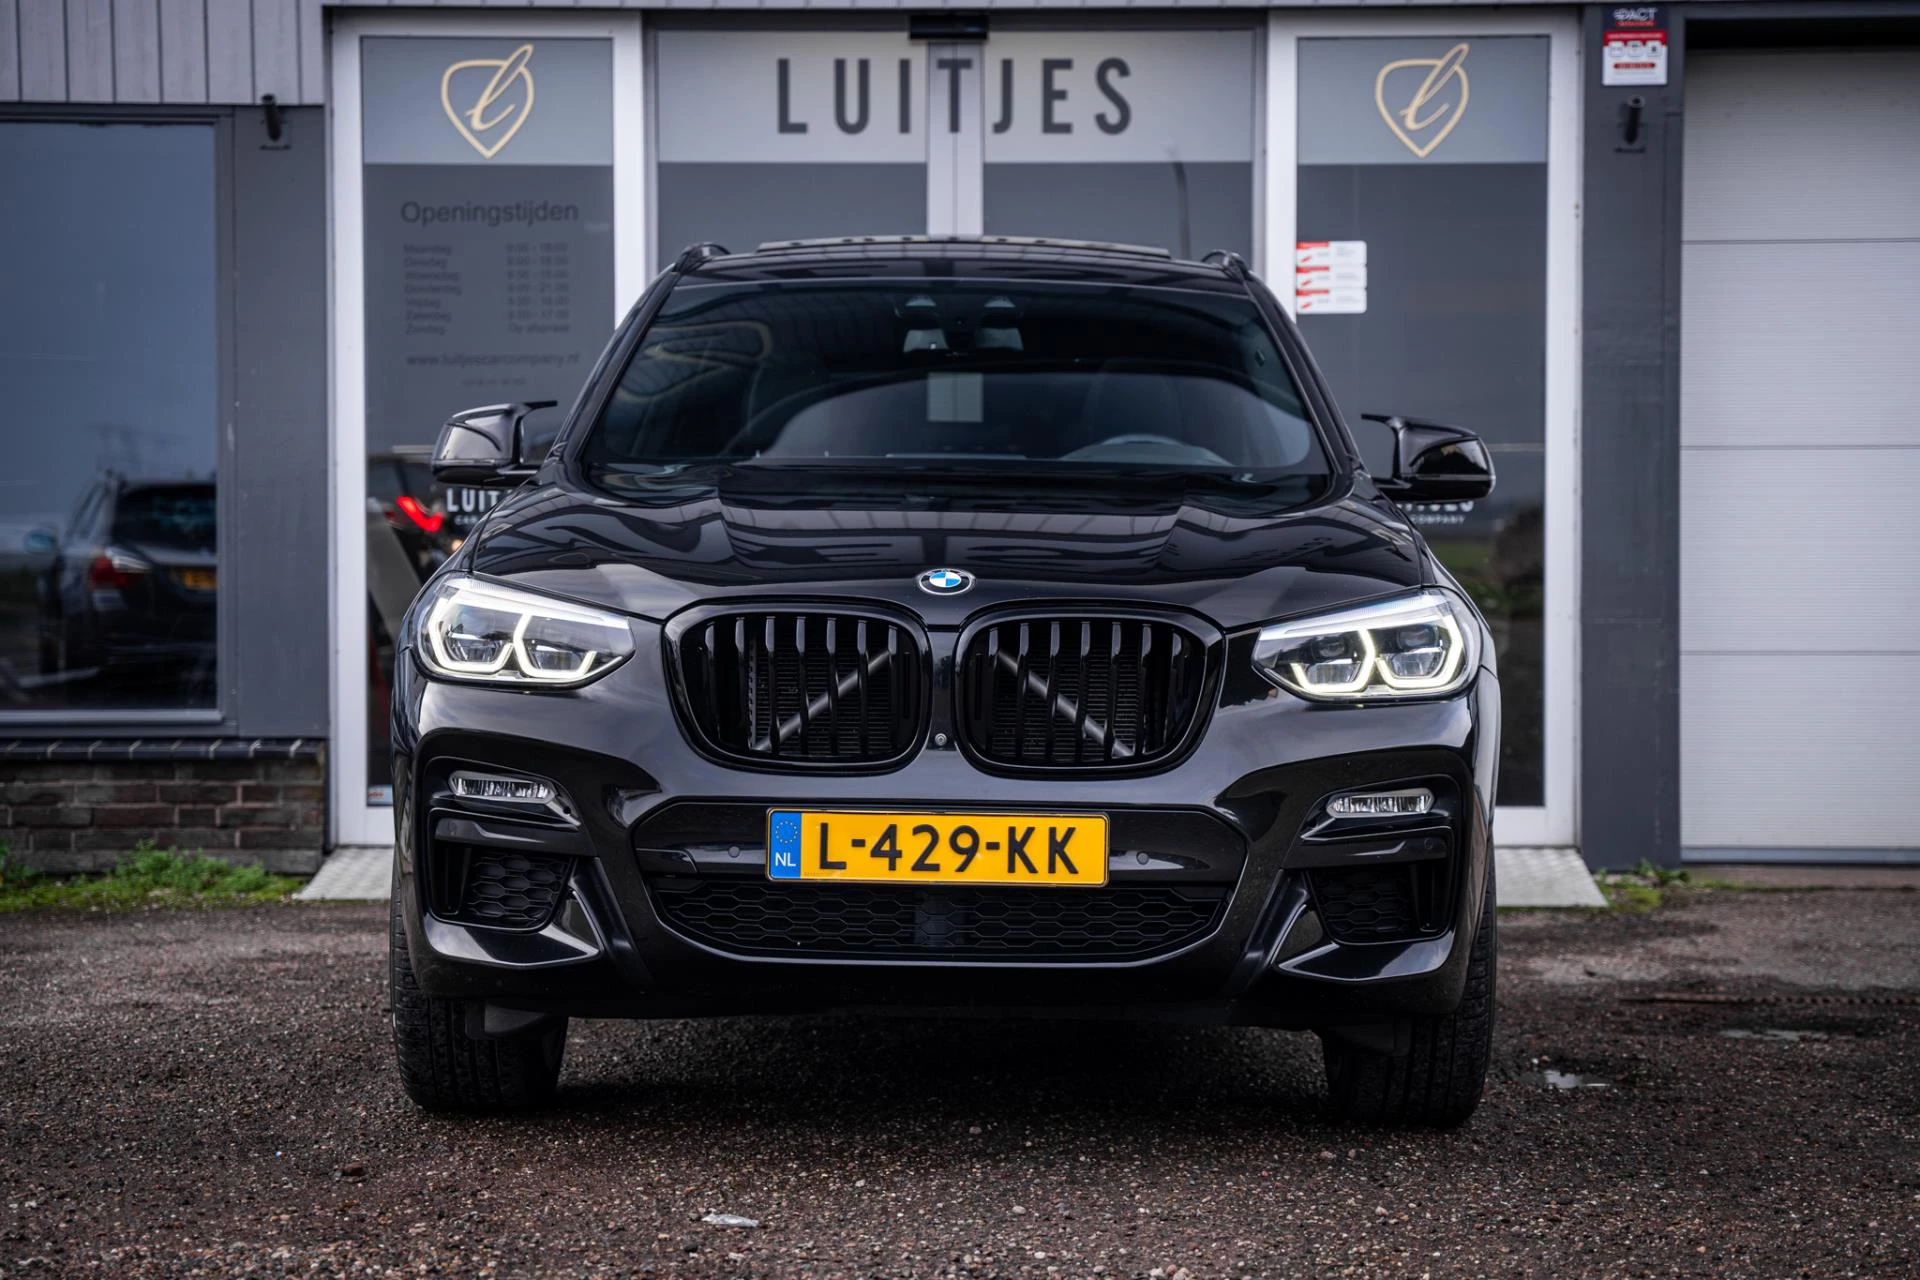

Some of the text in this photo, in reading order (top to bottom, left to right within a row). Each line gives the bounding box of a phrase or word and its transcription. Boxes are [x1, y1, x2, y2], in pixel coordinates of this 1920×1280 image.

[777, 57, 1132, 135] LUITJES
[400, 200, 580, 227] Openingstijden
[446, 487, 501, 513] LUIT
[775, 852, 797, 867] NL
[819, 822, 1080, 875] L-429-KK
